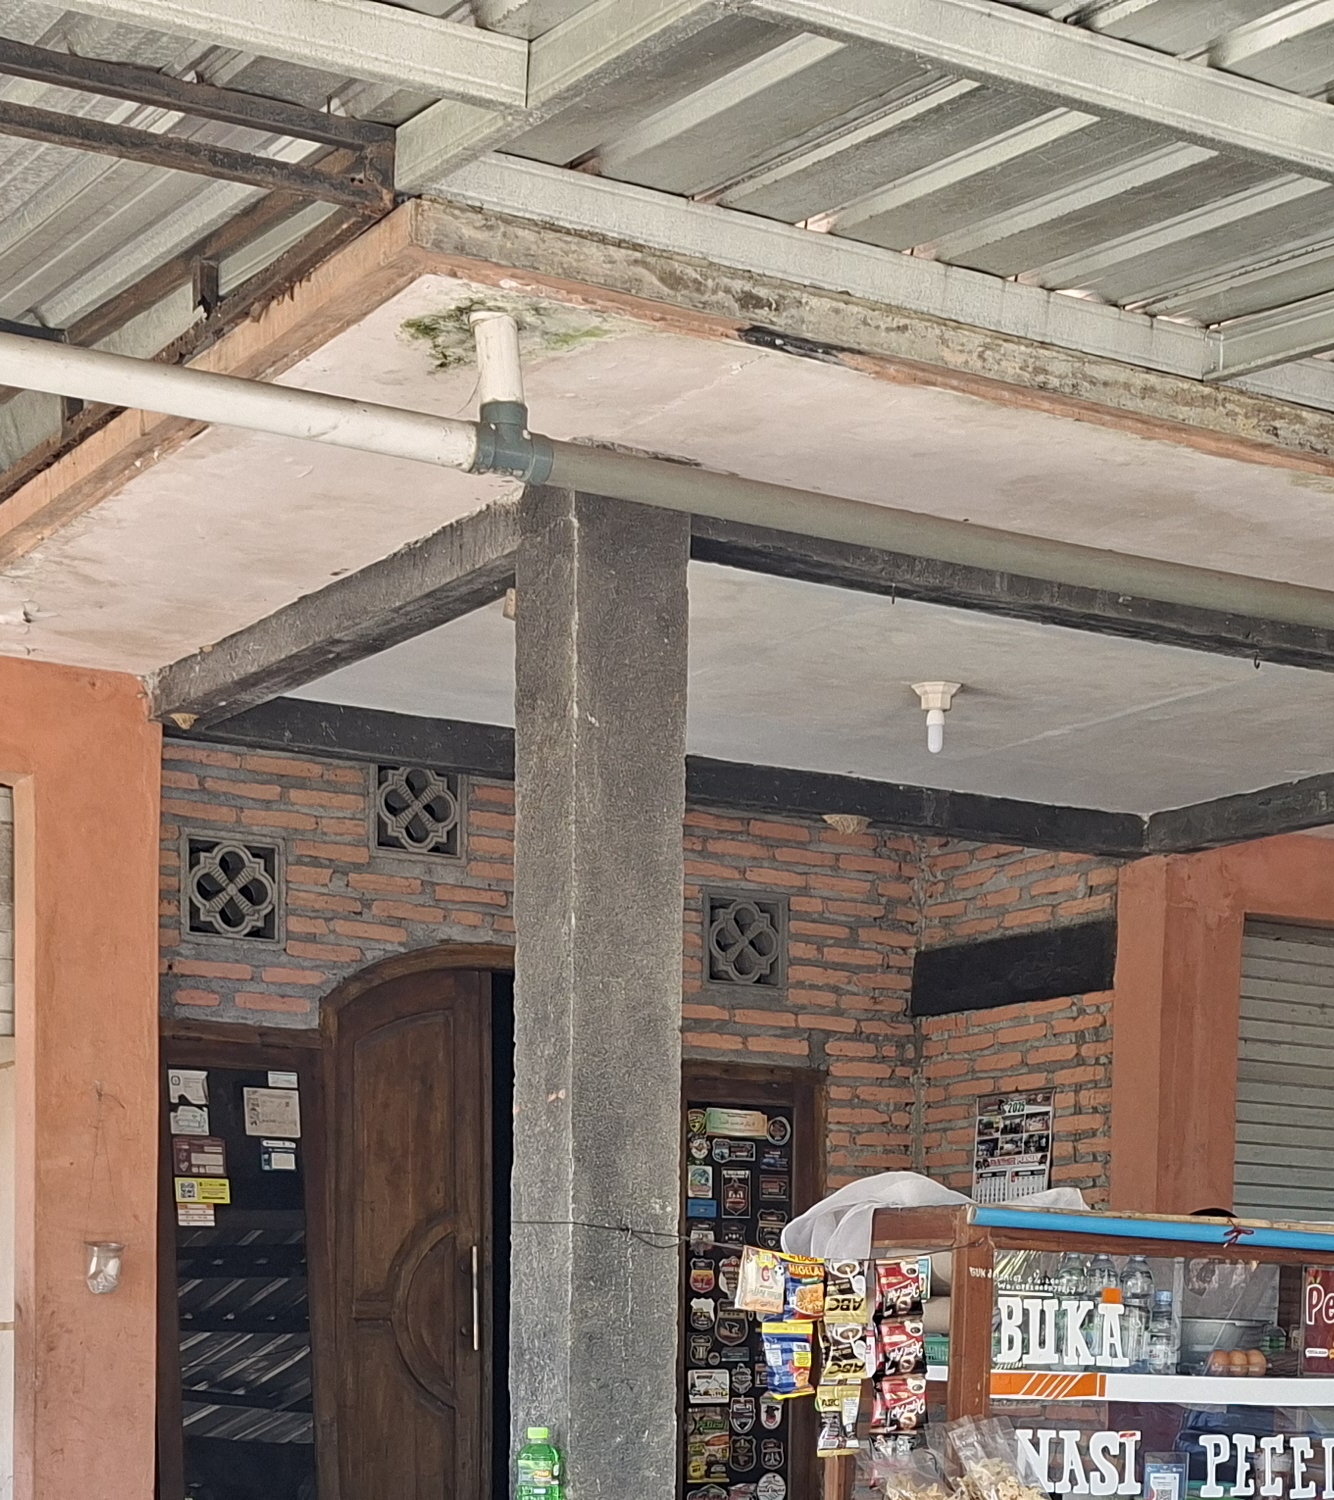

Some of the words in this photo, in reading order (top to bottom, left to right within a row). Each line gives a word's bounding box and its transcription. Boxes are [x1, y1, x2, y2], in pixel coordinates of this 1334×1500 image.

[827, 1297, 865, 1312] ABC
[996, 1296, 1130, 1368] BUKA
[828, 1361, 866, 1375] ABC
[1015, 1429, 1142, 1496] NASI
